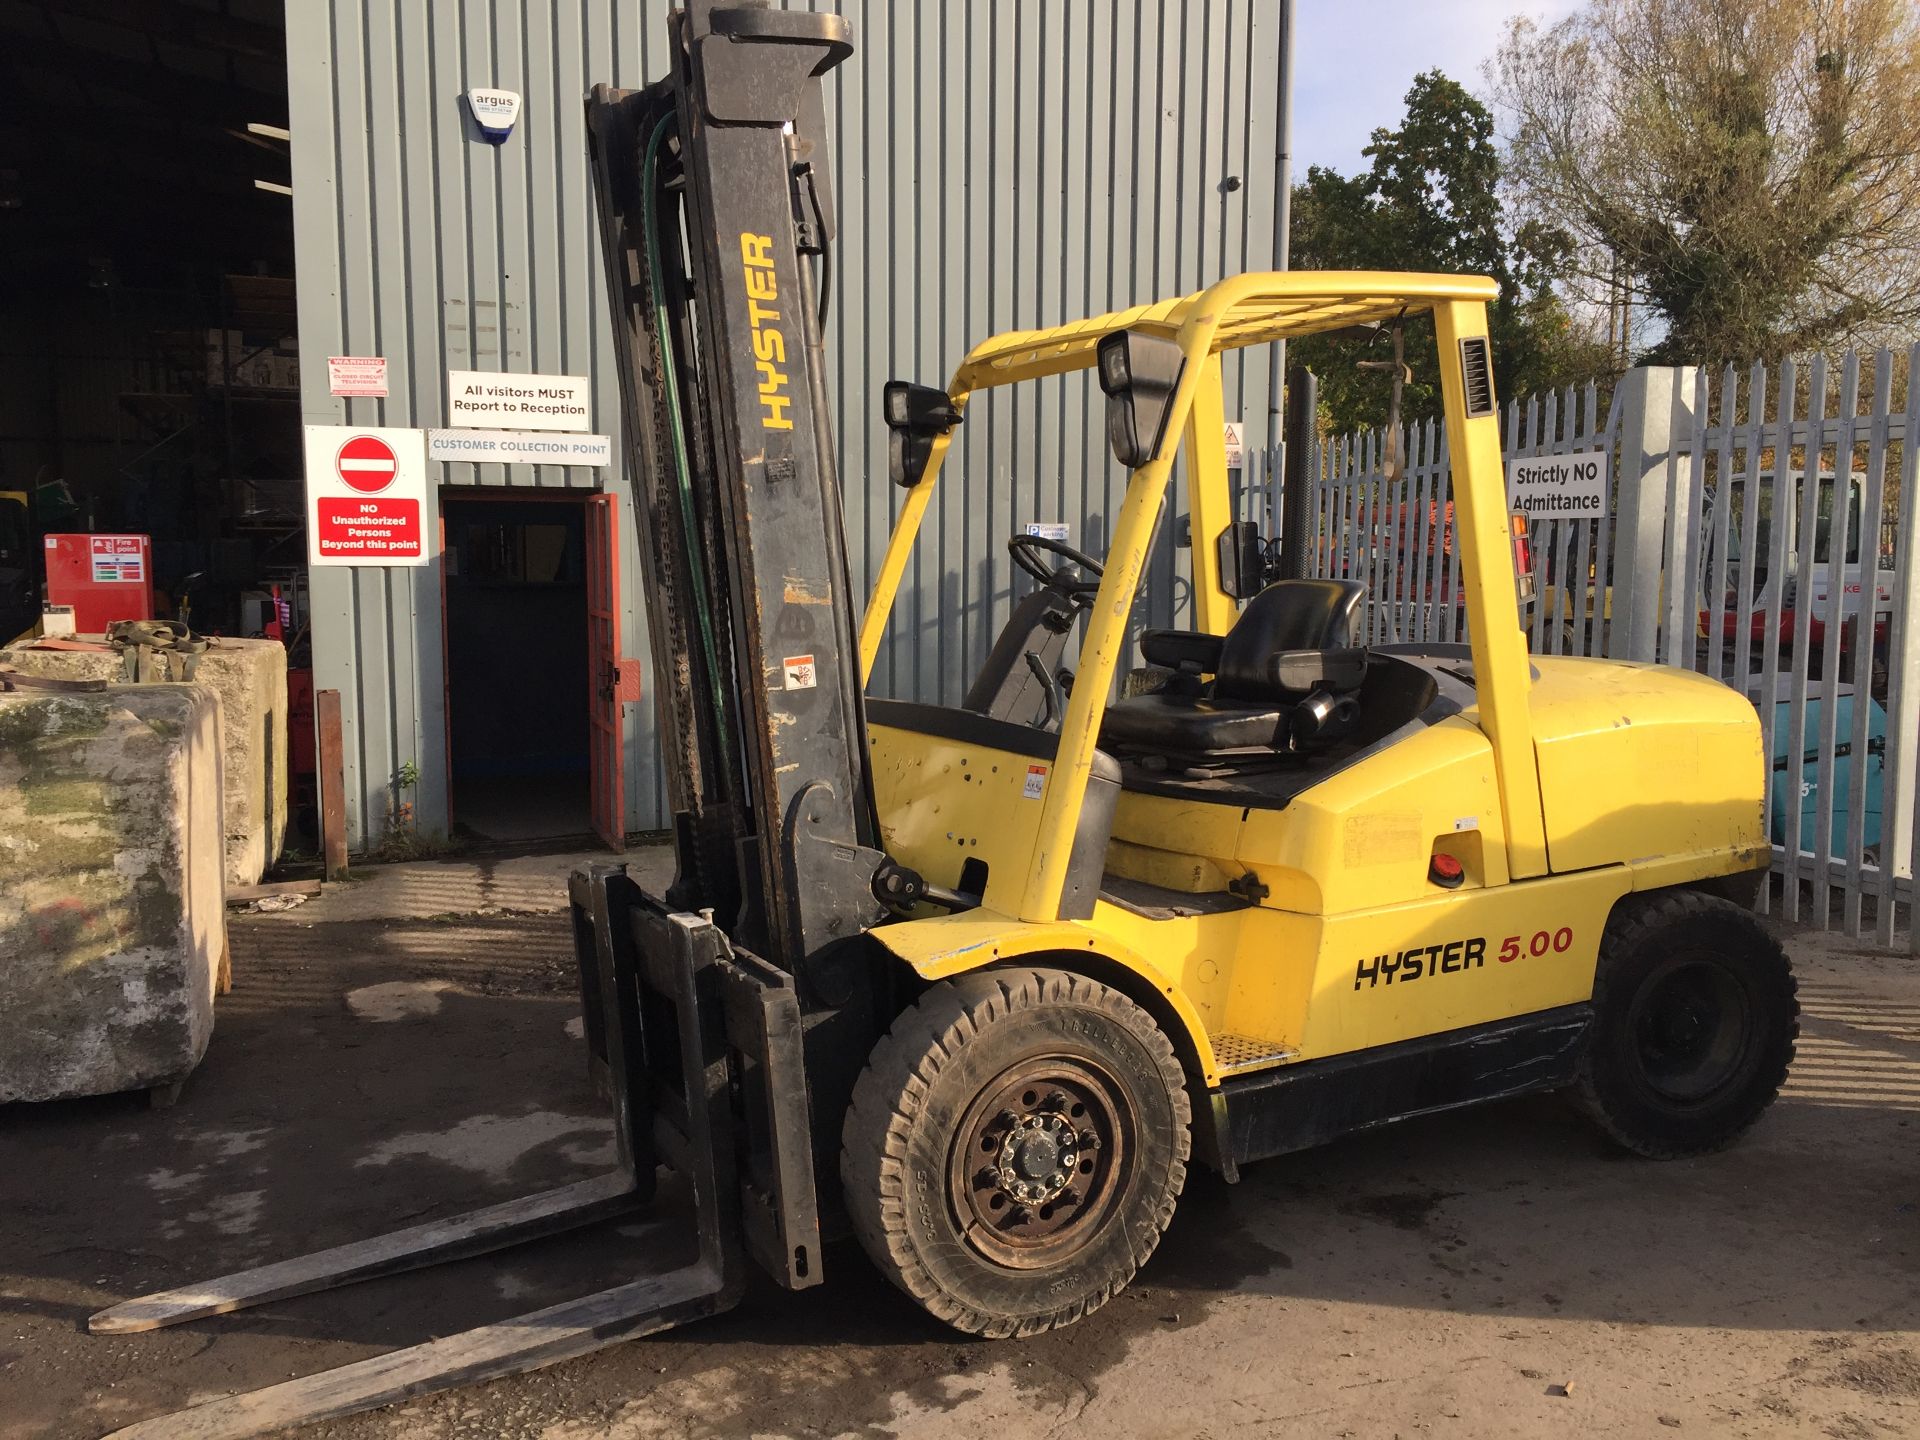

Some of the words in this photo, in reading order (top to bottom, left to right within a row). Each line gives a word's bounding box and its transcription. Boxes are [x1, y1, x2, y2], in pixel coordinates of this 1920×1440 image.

[476, 95, 514, 107] argus
[740, 232, 793, 430] HYSTER
[465, 385, 482, 396] All
[487, 386, 535, 398] visitors
[538, 389, 574, 400] MUST
[454, 400, 500, 413] Report
[504, 402, 517, 412] to
[521, 403, 585, 415] Reception
[433, 438, 496, 450] CUSTOMER
[500, 441, 568, 453] COLLECTION
[572, 444, 606, 454] POINT
[1517, 464, 1569, 486] Strictly
[1573, 462, 1598, 481] NO
[360, 504, 378, 513] NO
[1513, 493, 1600, 511] Admittance
[332, 515, 406, 526] Unauthorized
[348, 528, 391, 537] Persons
[321, 539, 364, 550] Beyond
[366, 540, 387, 549] this
[389, 540, 418, 550] point
[1354, 937, 1487, 991] HYSTER
[1498, 927, 1573, 963] 5.00
